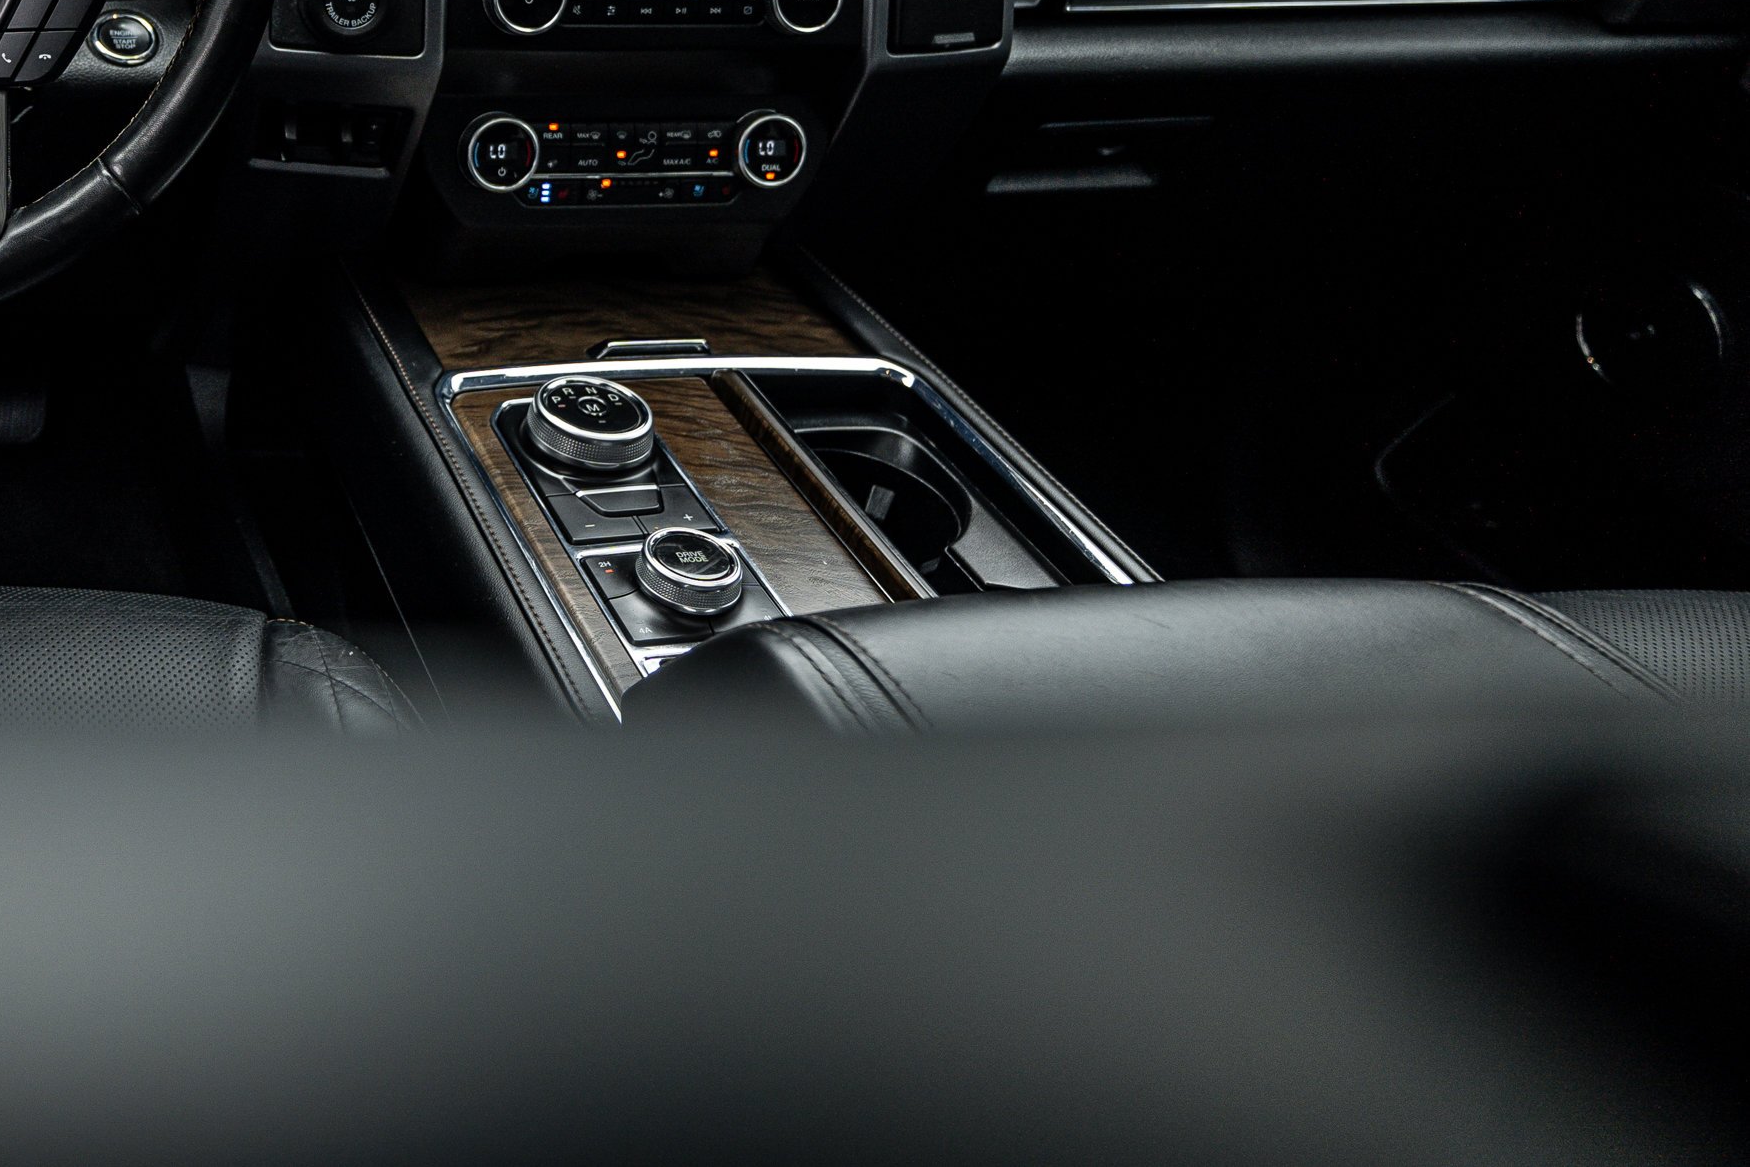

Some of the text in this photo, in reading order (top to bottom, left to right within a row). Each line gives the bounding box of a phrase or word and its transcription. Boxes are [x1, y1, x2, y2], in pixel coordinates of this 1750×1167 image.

[325, 1, 378, 27] TRAILER BACKUP
[489, 143, 506, 159] LO
[758, 140, 775, 156] LO
[577, 159, 599, 167] AUTO
[761, 164, 782, 172] DUAL
[562, 387, 575, 396] R
[585, 386, 598, 394] N
[551, 395, 562, 404] P
[607, 394, 619, 402] D
[585, 403, 601, 412] M
[675, 550, 704, 558] DRIVE
[598, 561, 611, 569] 2H
[638, 626, 652, 634] 4A
